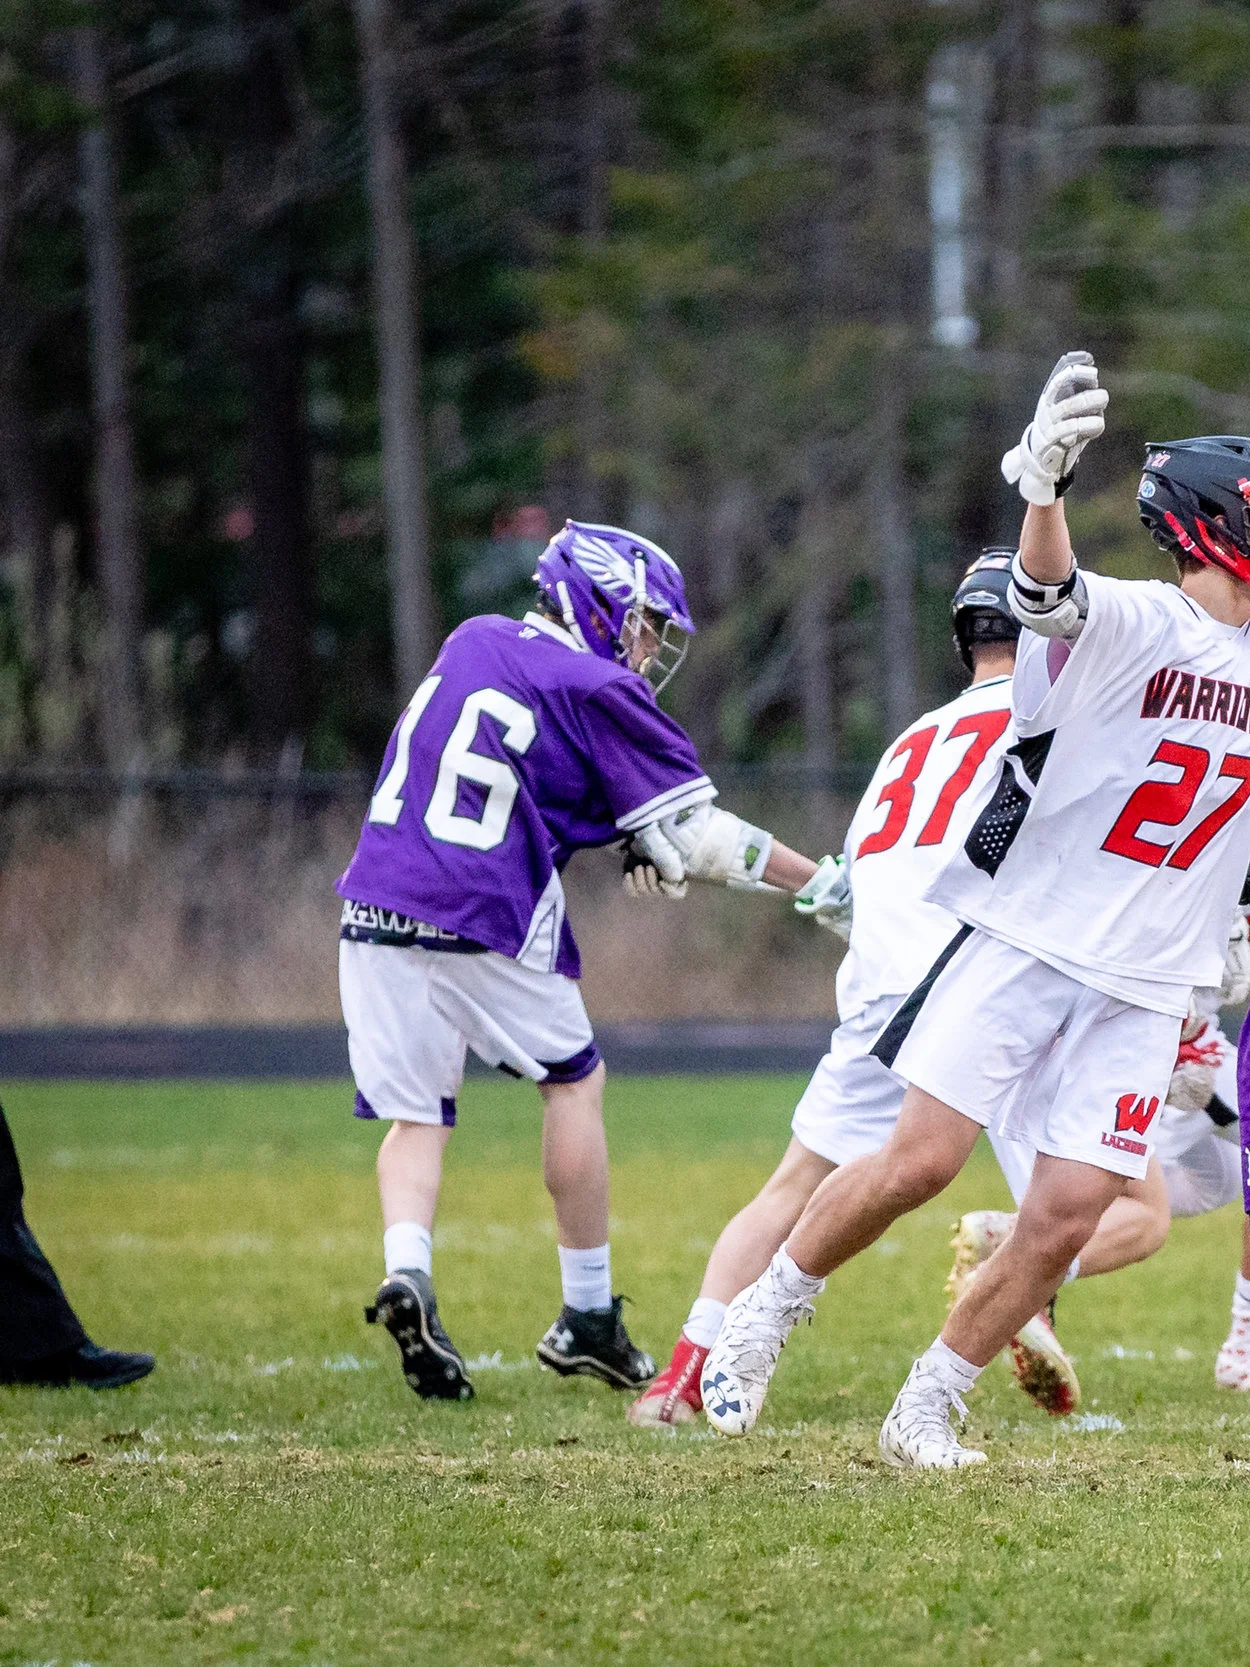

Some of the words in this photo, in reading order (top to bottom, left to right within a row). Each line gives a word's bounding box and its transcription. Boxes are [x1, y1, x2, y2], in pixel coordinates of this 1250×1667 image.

[368, 674, 538, 851] 16
[854, 708, 1012, 862] 37
[1114, 1093, 1160, 1136] W
